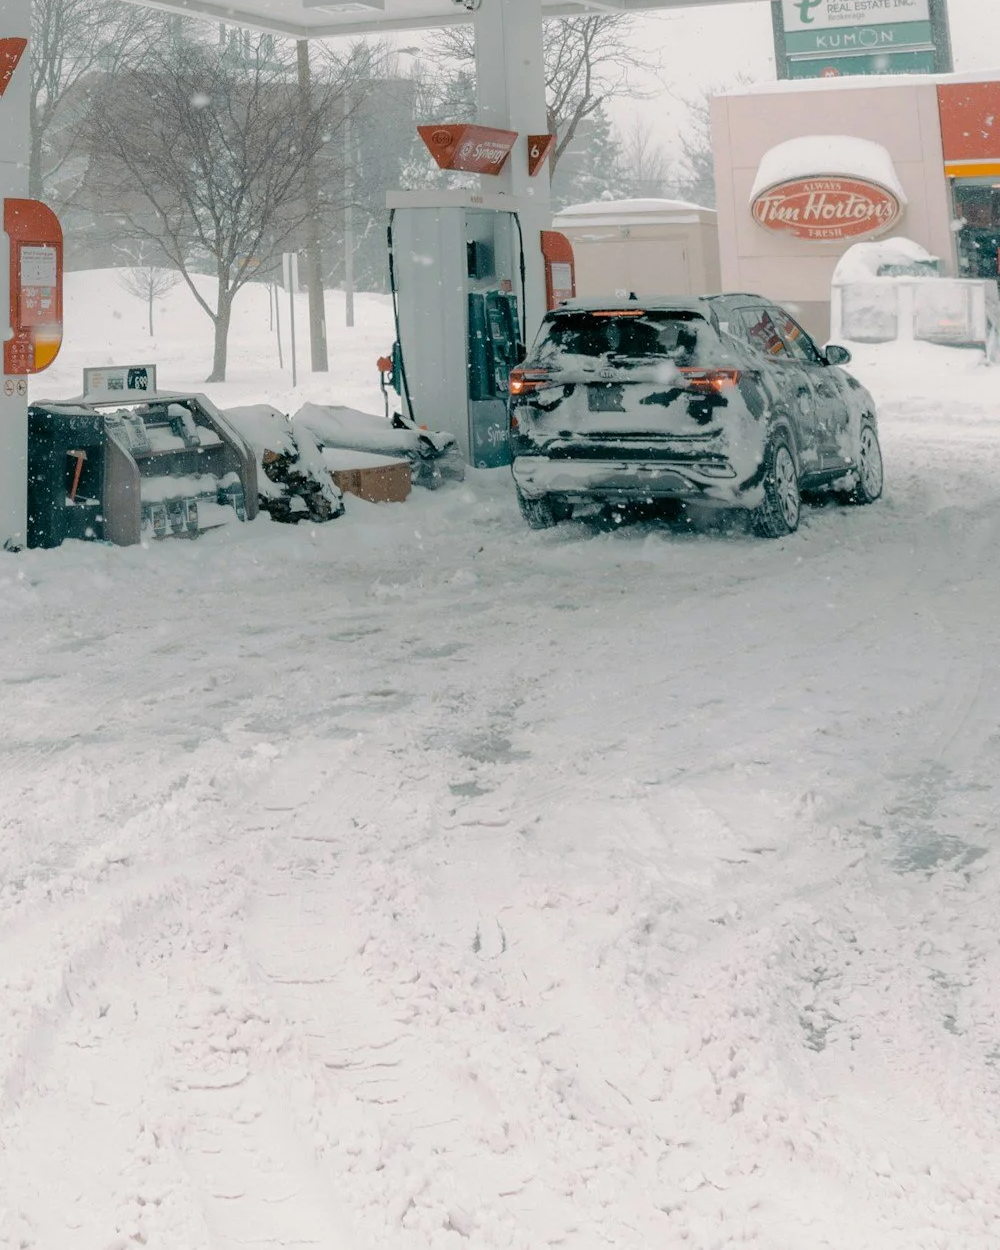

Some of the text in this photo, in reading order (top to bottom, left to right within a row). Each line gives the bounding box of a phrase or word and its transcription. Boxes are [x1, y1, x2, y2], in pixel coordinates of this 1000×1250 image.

[827, 4, 853, 13] REAL
[854, 0, 891, 11] ESTATE
[816, 28, 894, 48] KUMON
[472, 143, 506, 164] Synergy
[530, 146, 539, 158] 6
[803, 182, 842, 192] ALWAYS
[756, 194, 798, 222] Tim
[808, 228, 842, 238] FRESH
